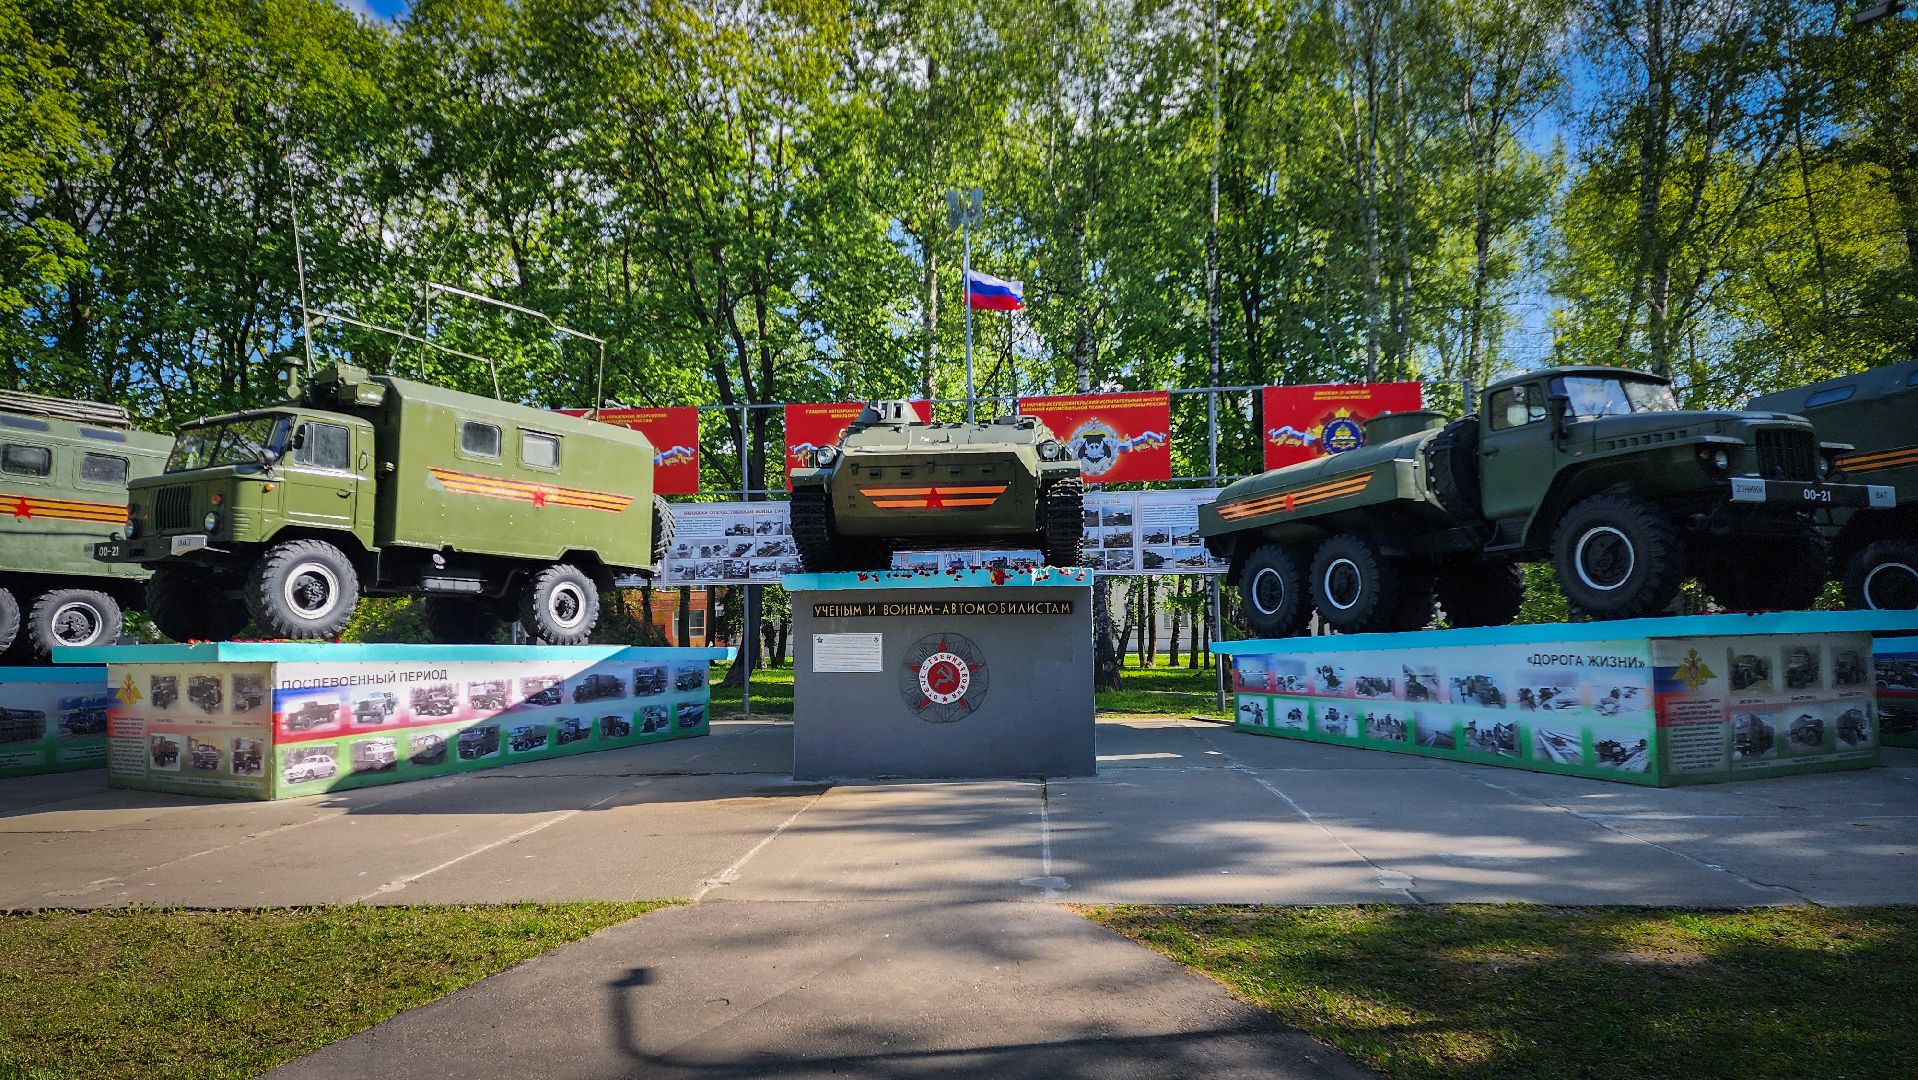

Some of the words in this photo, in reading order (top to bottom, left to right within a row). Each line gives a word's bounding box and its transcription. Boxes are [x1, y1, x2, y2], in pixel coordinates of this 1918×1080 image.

[814, 604, 862, 617] УЧЕНЫМ
[868, 604, 876, 616] И
[883, 602, 1071, 616] ВОИНАМ-АВТОМОБИЛИСТАМ
[1527, 653, 1584, 667] «ДОРОГА
[1587, 655, 1646, 669] ЖИЗНИ»
[281, 670, 396, 691] ПОСЛЕВОЕННЫЙ
[399, 669, 448, 683] ПЕРИОД
